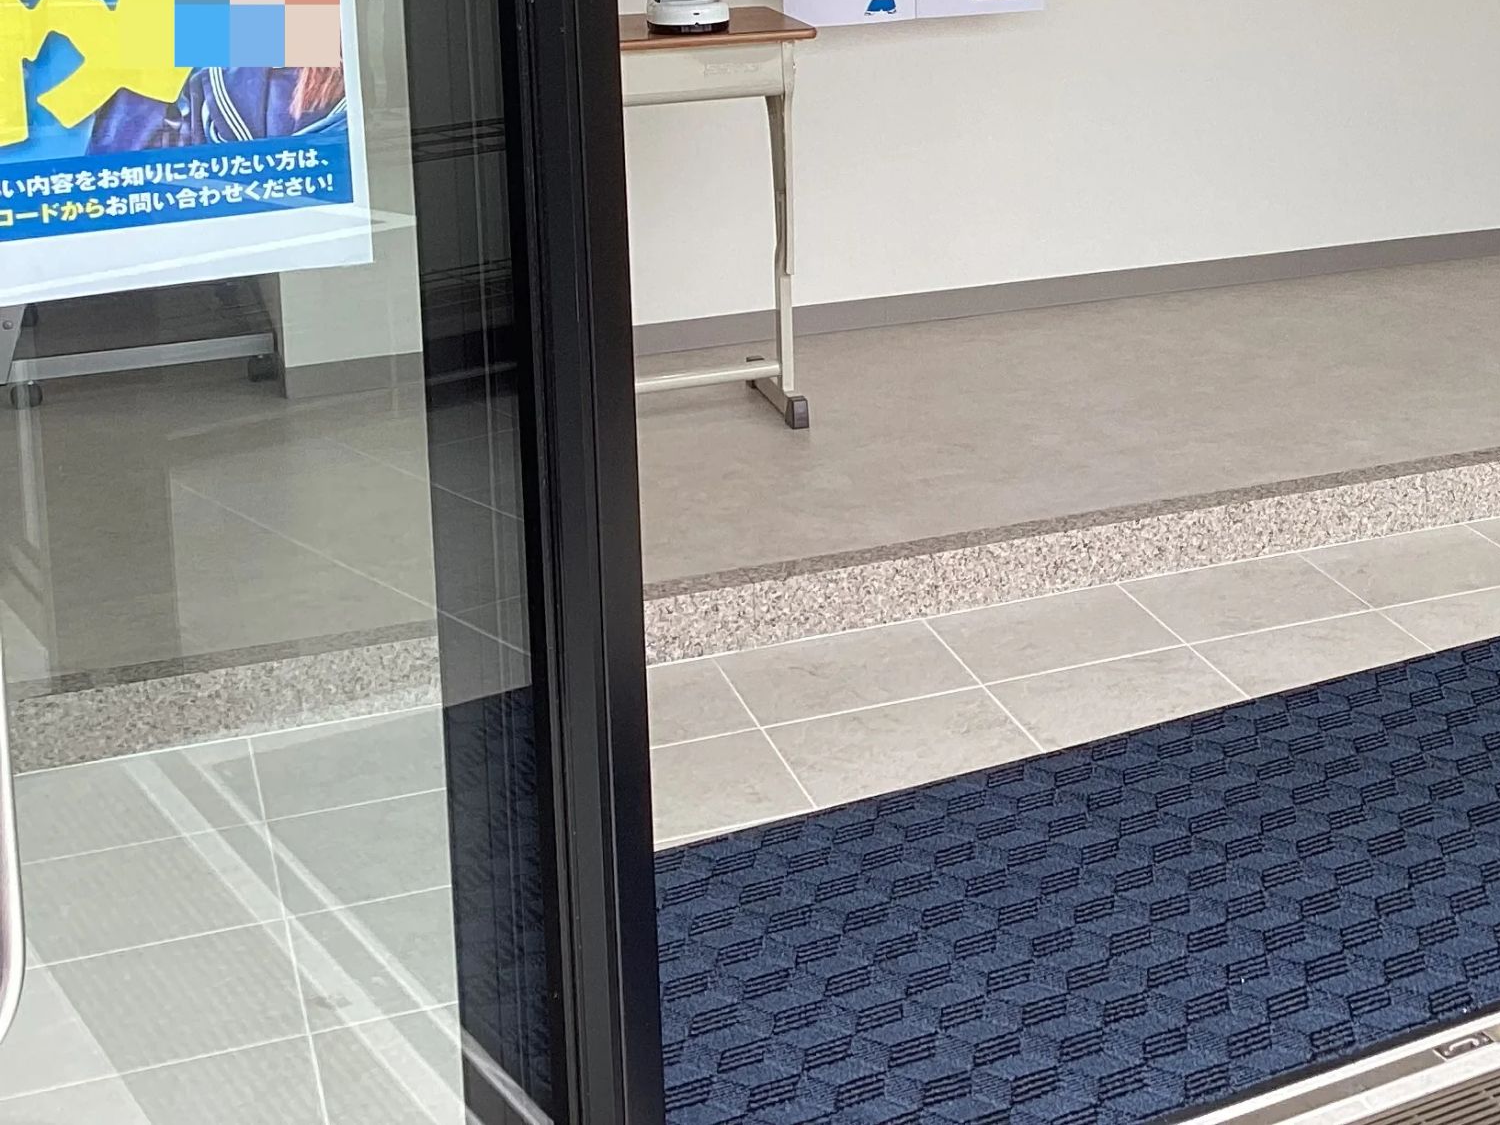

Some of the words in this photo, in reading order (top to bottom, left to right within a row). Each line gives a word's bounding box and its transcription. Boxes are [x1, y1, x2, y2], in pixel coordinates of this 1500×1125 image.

[0, 148, 329, 199] い内容をお知りになりたい方は、
